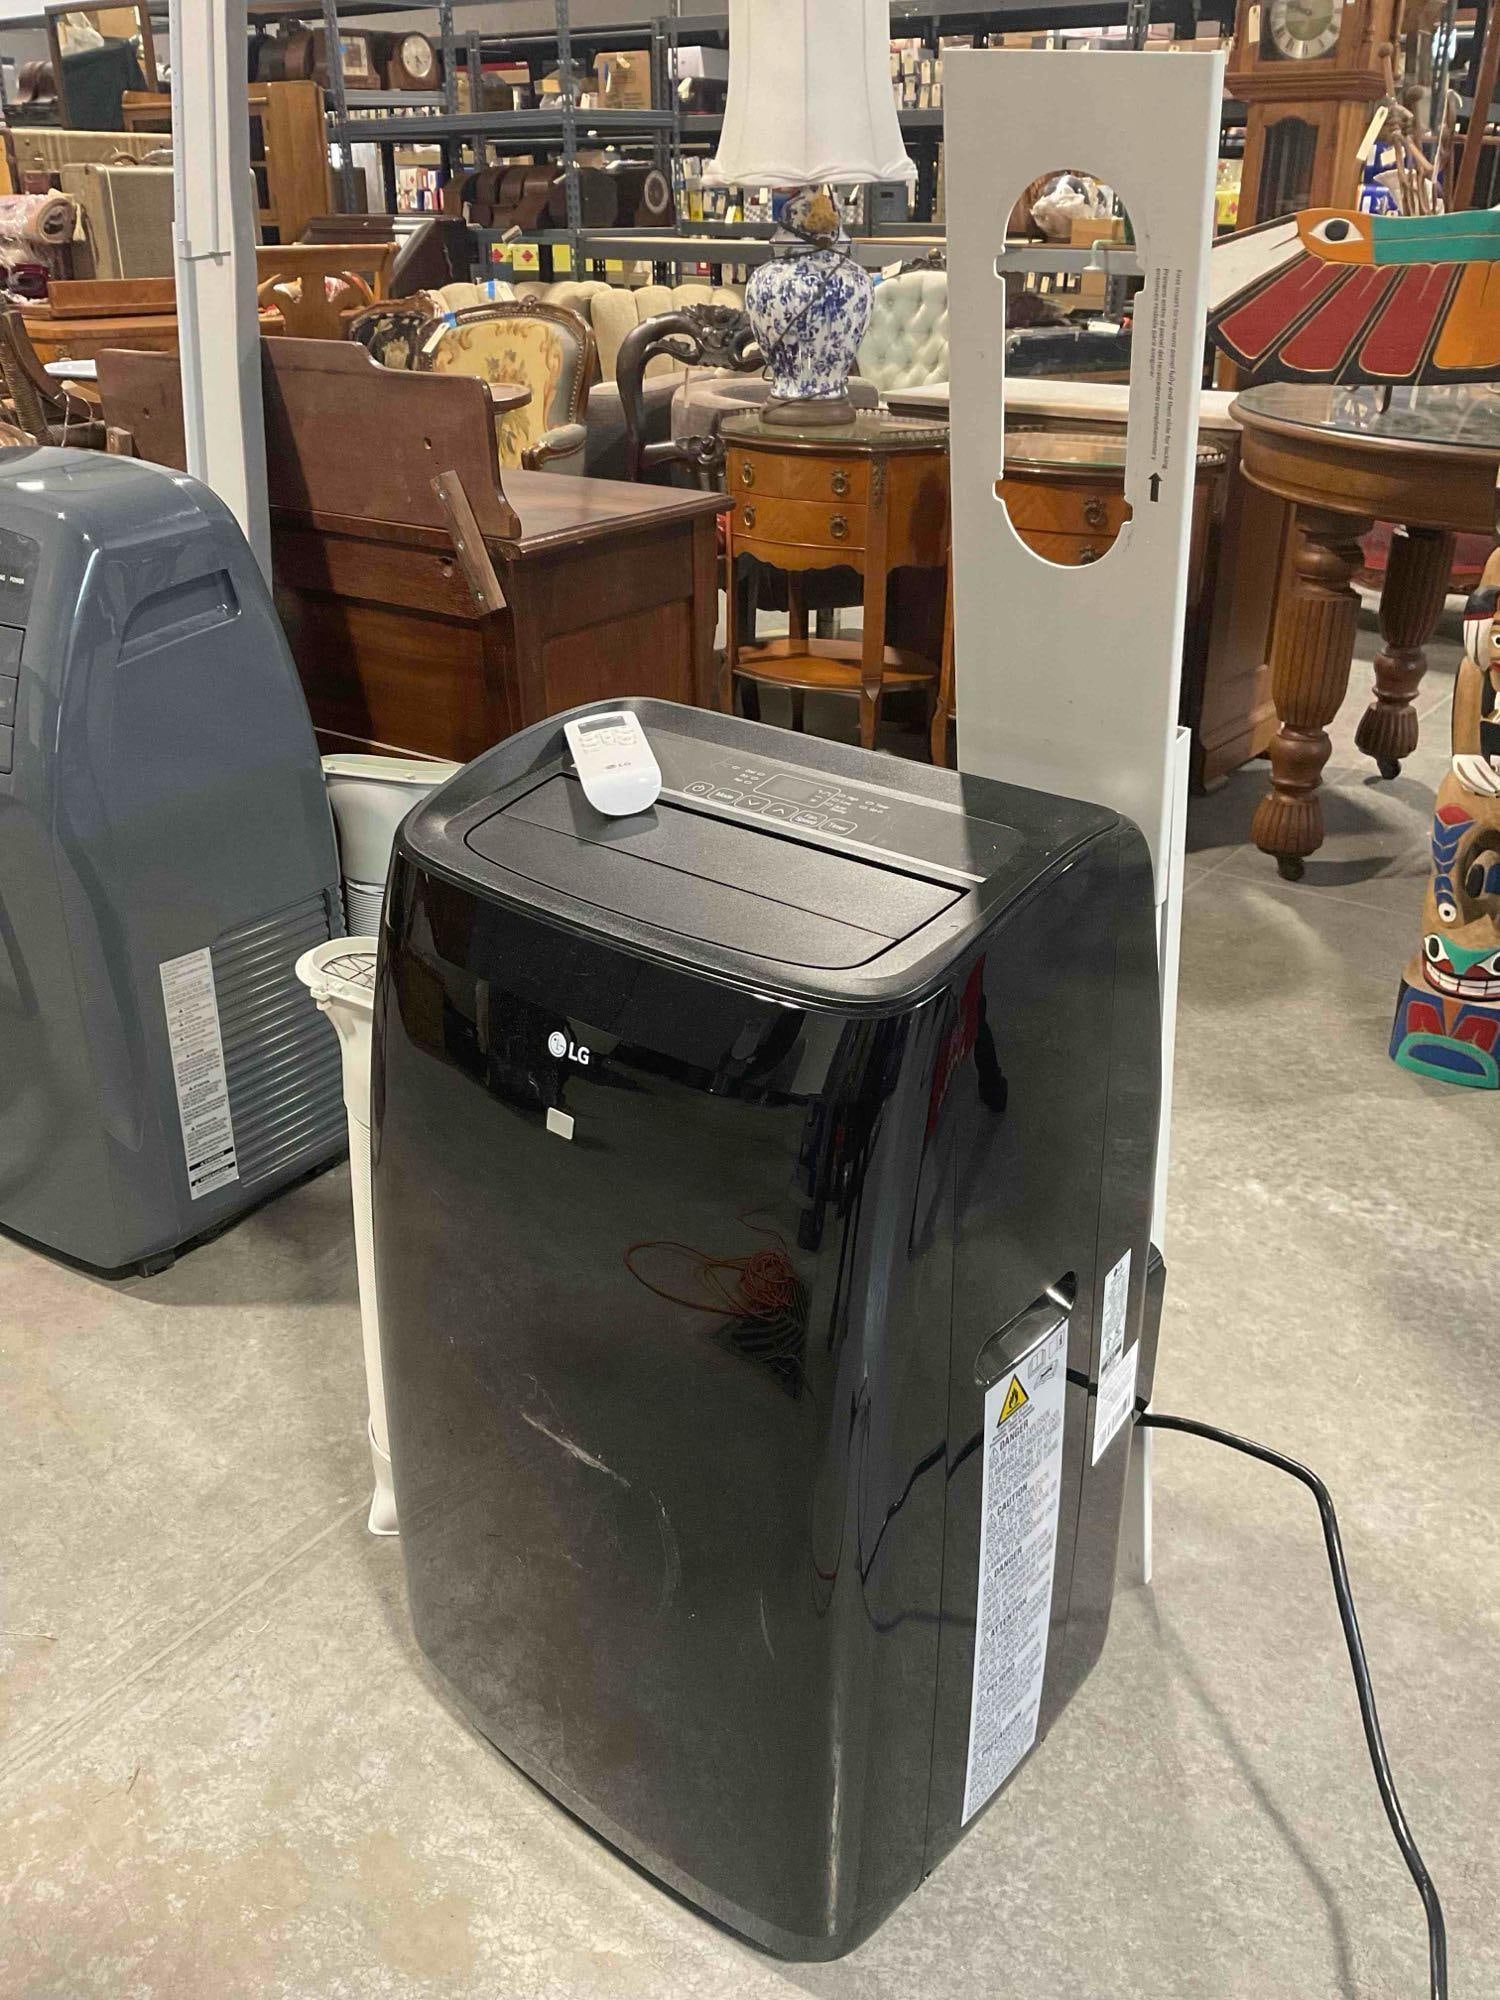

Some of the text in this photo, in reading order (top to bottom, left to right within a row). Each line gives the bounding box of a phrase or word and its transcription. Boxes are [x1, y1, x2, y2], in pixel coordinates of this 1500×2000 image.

[568, 1041, 590, 1065] LG
[999, 1417, 1028, 1452] DANGER
[997, 1481, 1027, 1516] CAUTION
[994, 1544, 1022, 1579] DANGER
[990, 1595, 1027, 1639] ATTENTION
